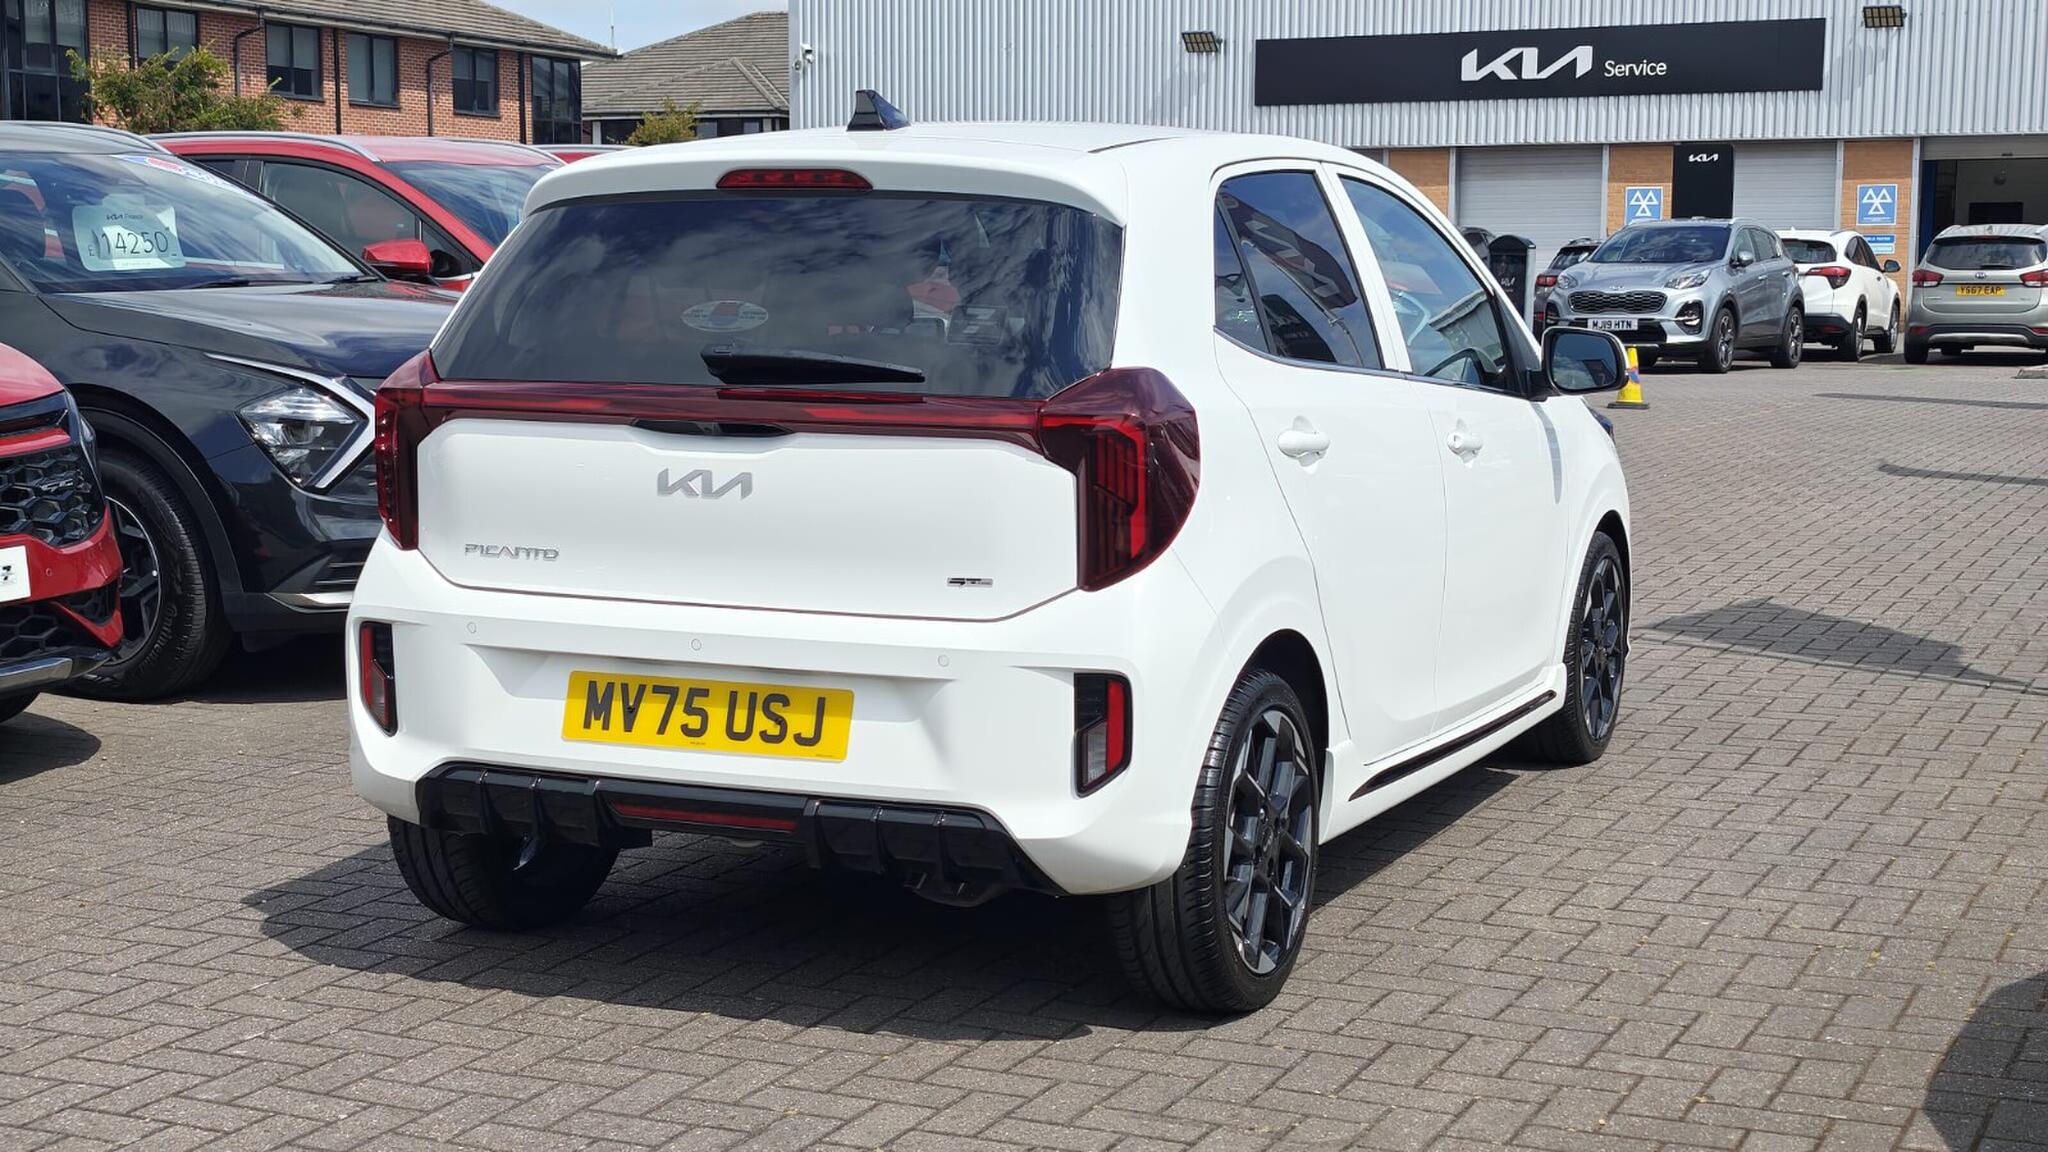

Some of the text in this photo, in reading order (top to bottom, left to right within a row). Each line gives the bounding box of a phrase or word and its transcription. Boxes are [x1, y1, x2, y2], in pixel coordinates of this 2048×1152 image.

[1461, 45, 1667, 81] KIA Service
[1688, 153, 1719, 162] KIA
[1614, 320, 1632, 329] HTN
[657, 467, 753, 500] KIA
[464, 543, 560, 562] PICANTO
[583, 680, 826, 747] MV75 USJ
